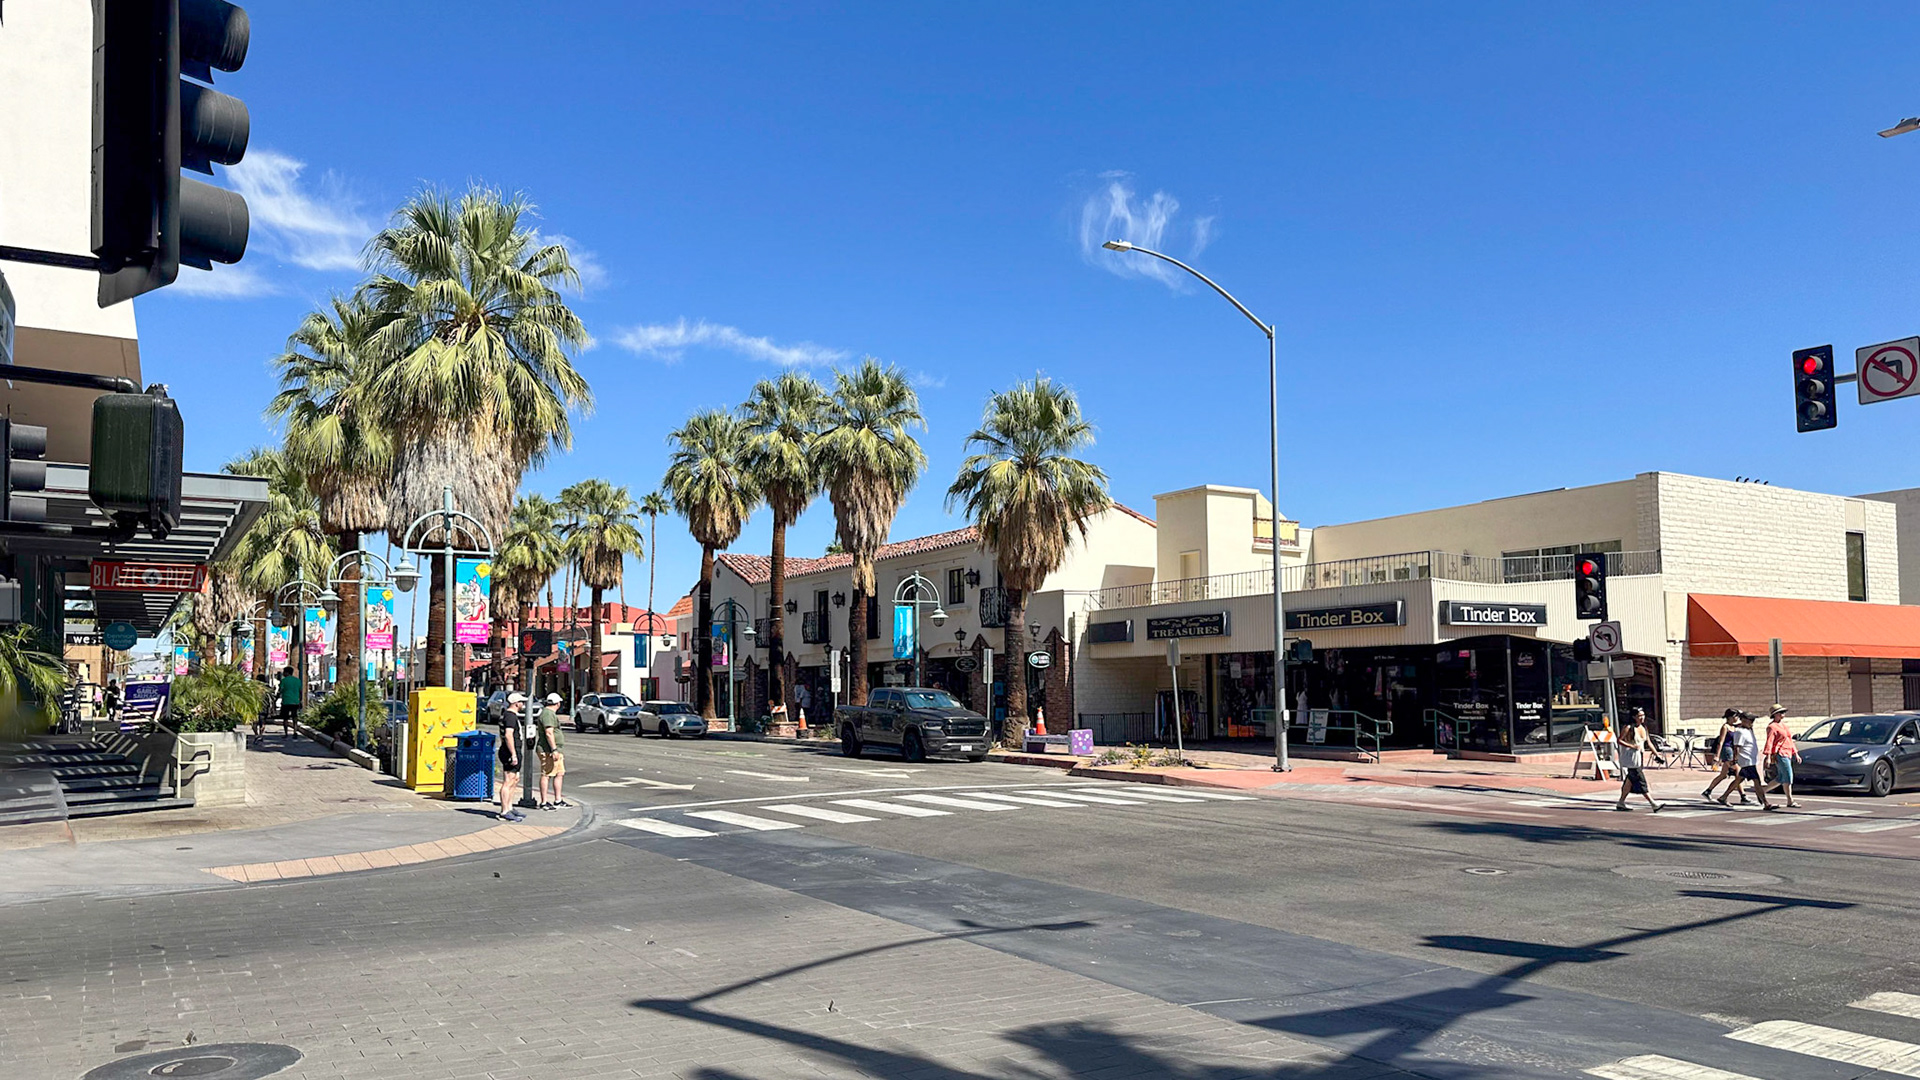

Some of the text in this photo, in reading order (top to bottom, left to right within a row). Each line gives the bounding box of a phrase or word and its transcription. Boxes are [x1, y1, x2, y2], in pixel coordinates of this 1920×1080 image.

[93, 564, 204, 590] BLAZE PIZZA
[1296, 609, 1384, 628] Tinder Box
[1459, 606, 1537, 623] Tinder Box
[1151, 625, 1220, 638] TREASURES
